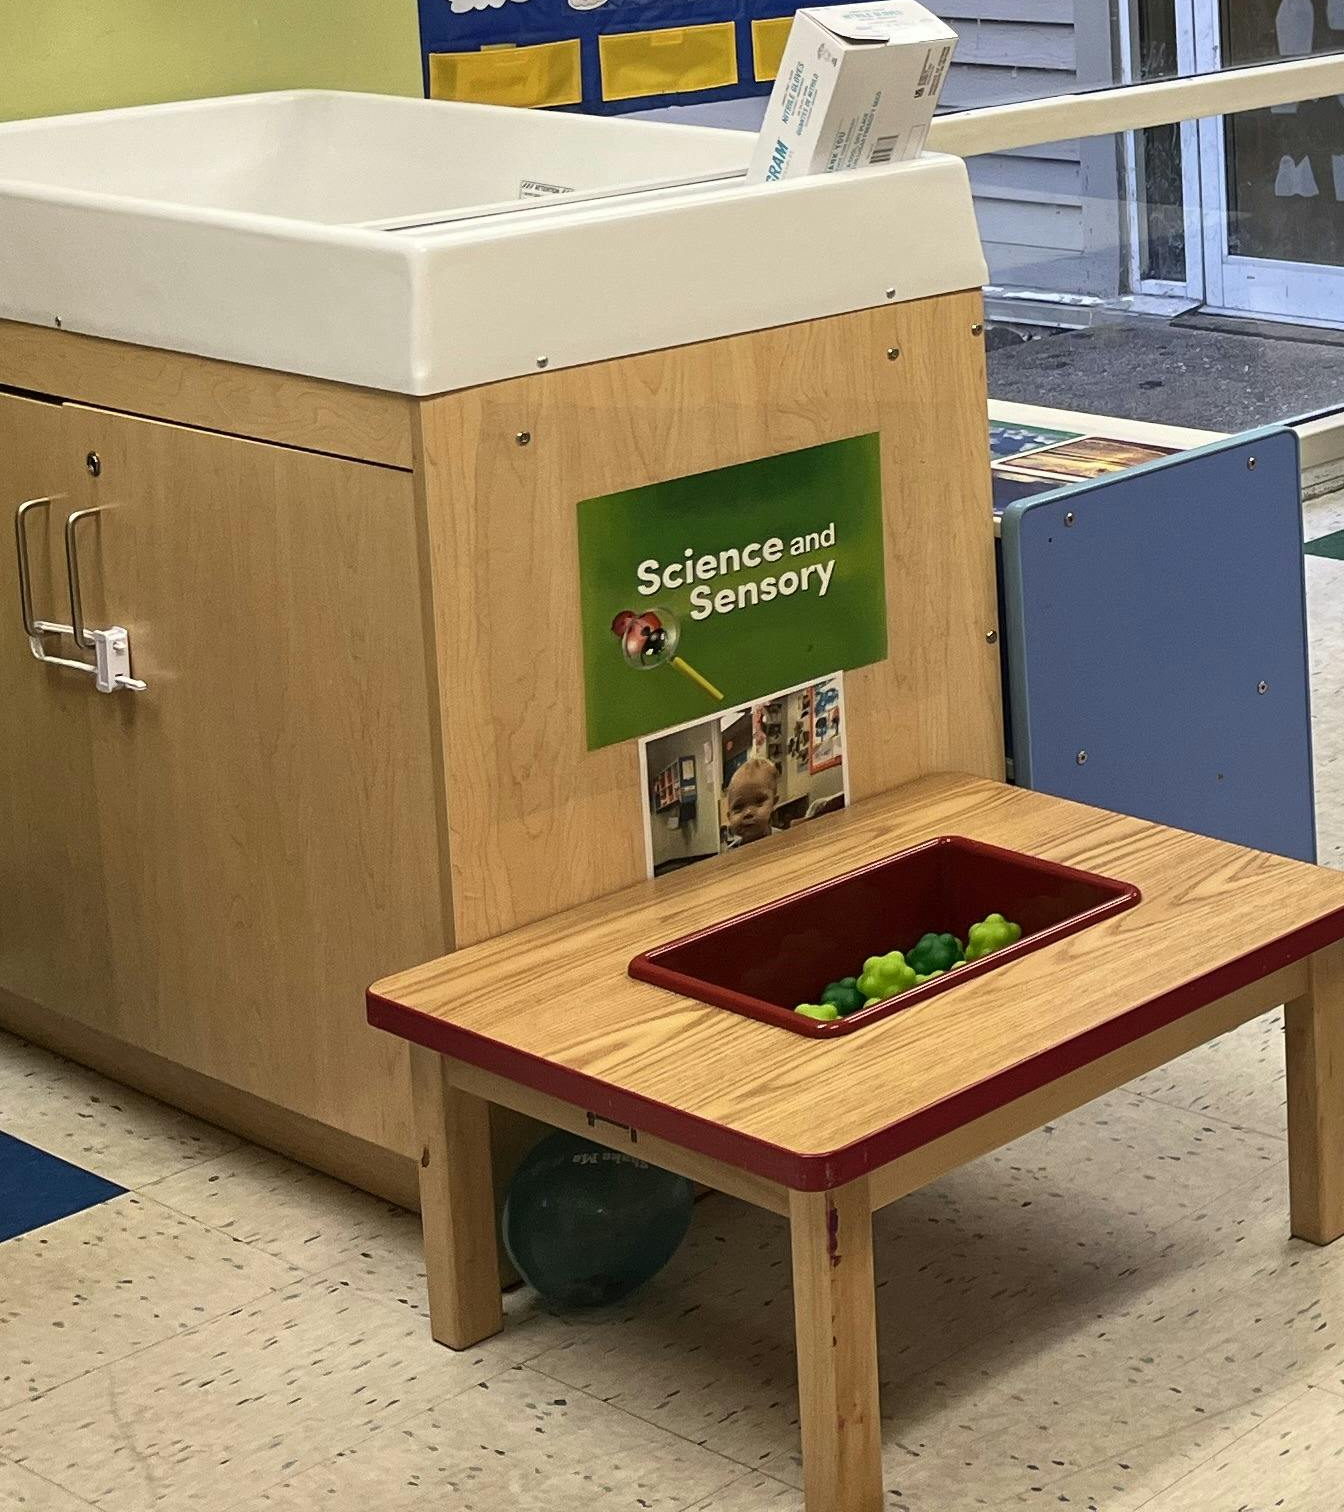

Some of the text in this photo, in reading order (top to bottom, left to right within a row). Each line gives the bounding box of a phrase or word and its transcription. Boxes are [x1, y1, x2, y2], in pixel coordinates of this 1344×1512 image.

[636, 522, 838, 597] Science and
[688, 558, 837, 622] Sensory
